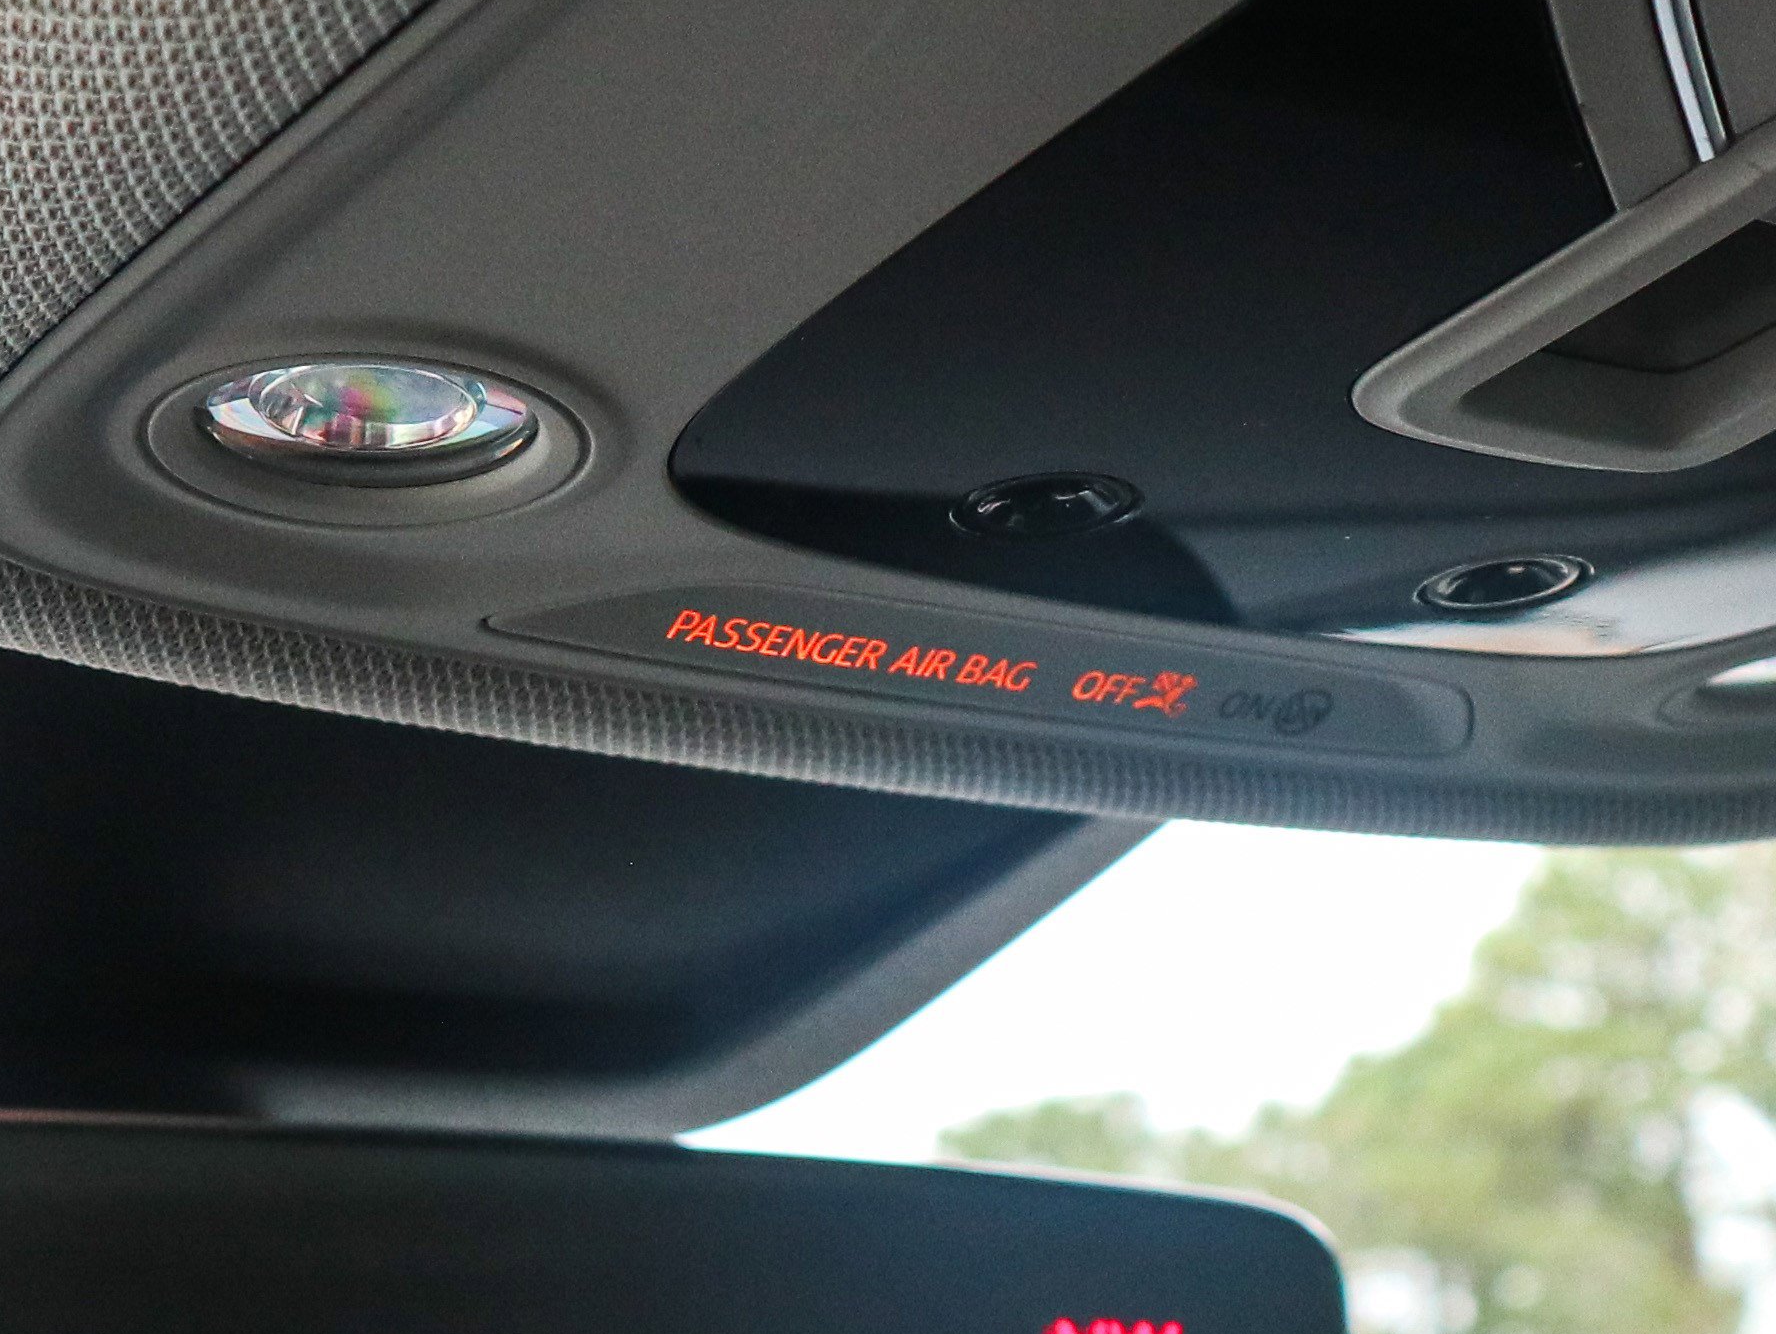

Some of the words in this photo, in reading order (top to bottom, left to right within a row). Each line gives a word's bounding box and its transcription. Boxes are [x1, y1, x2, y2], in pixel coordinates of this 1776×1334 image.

[666, 609, 889, 670] PASSENGER
[889, 645, 957, 679] AIR
[955, 654, 1038, 692] BAG
[1071, 670, 1146, 705] OFF
